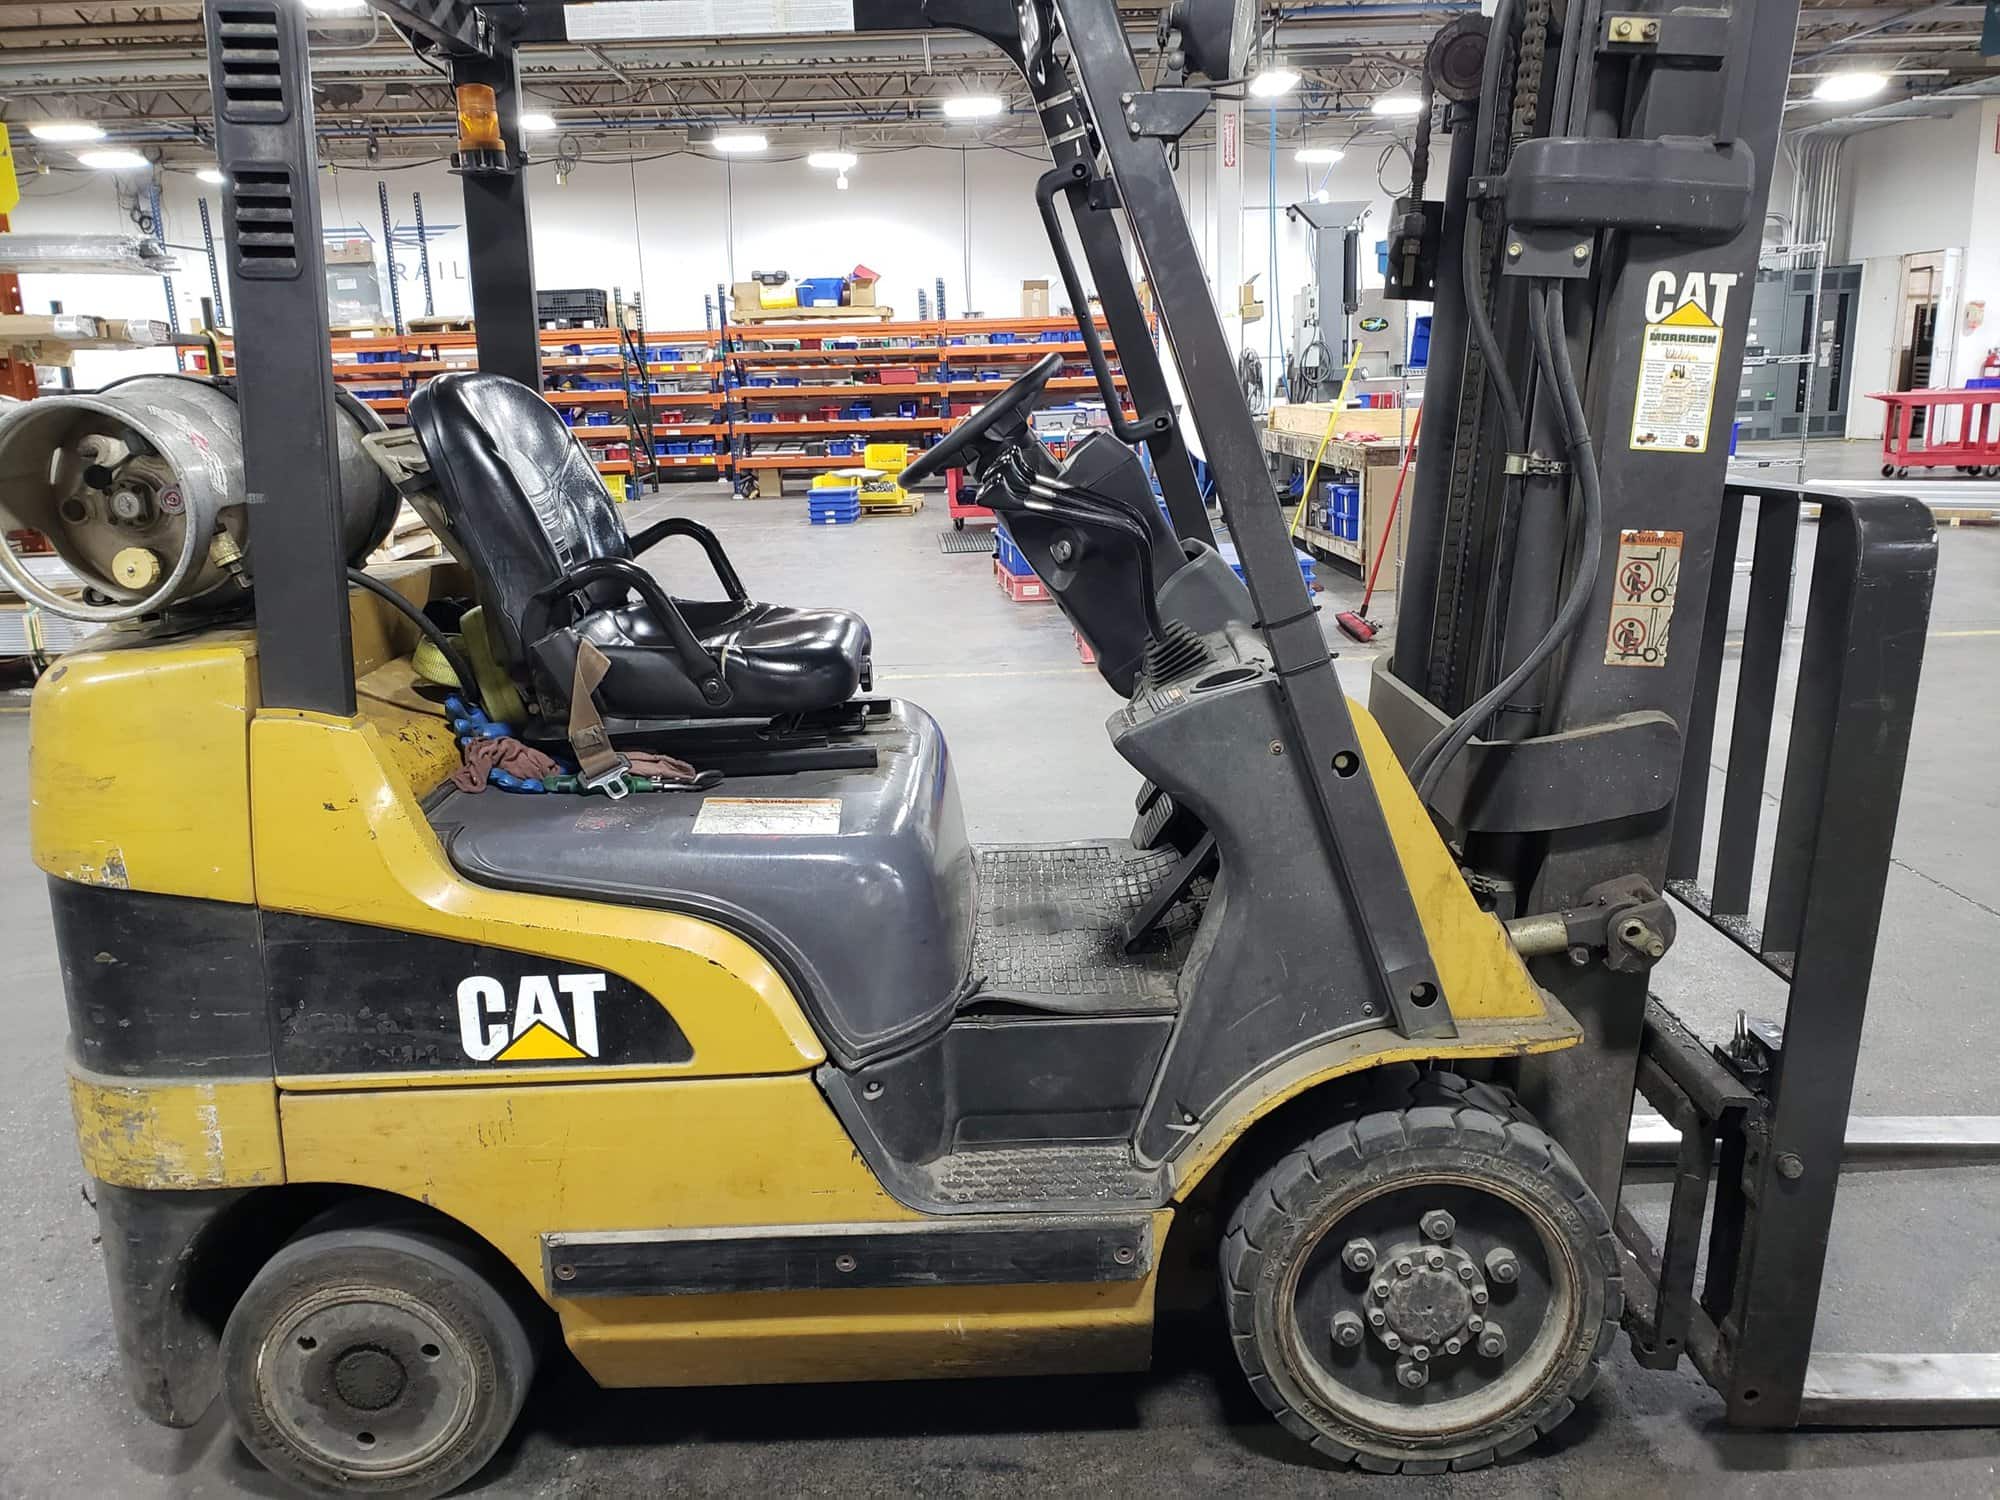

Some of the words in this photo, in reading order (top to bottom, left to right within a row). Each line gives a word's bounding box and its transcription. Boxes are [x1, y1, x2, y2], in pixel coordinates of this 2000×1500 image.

[1645, 270, 1738, 328] CAT
[1649, 332, 1717, 344] MORRISON
[456, 973, 607, 1062] CAT
